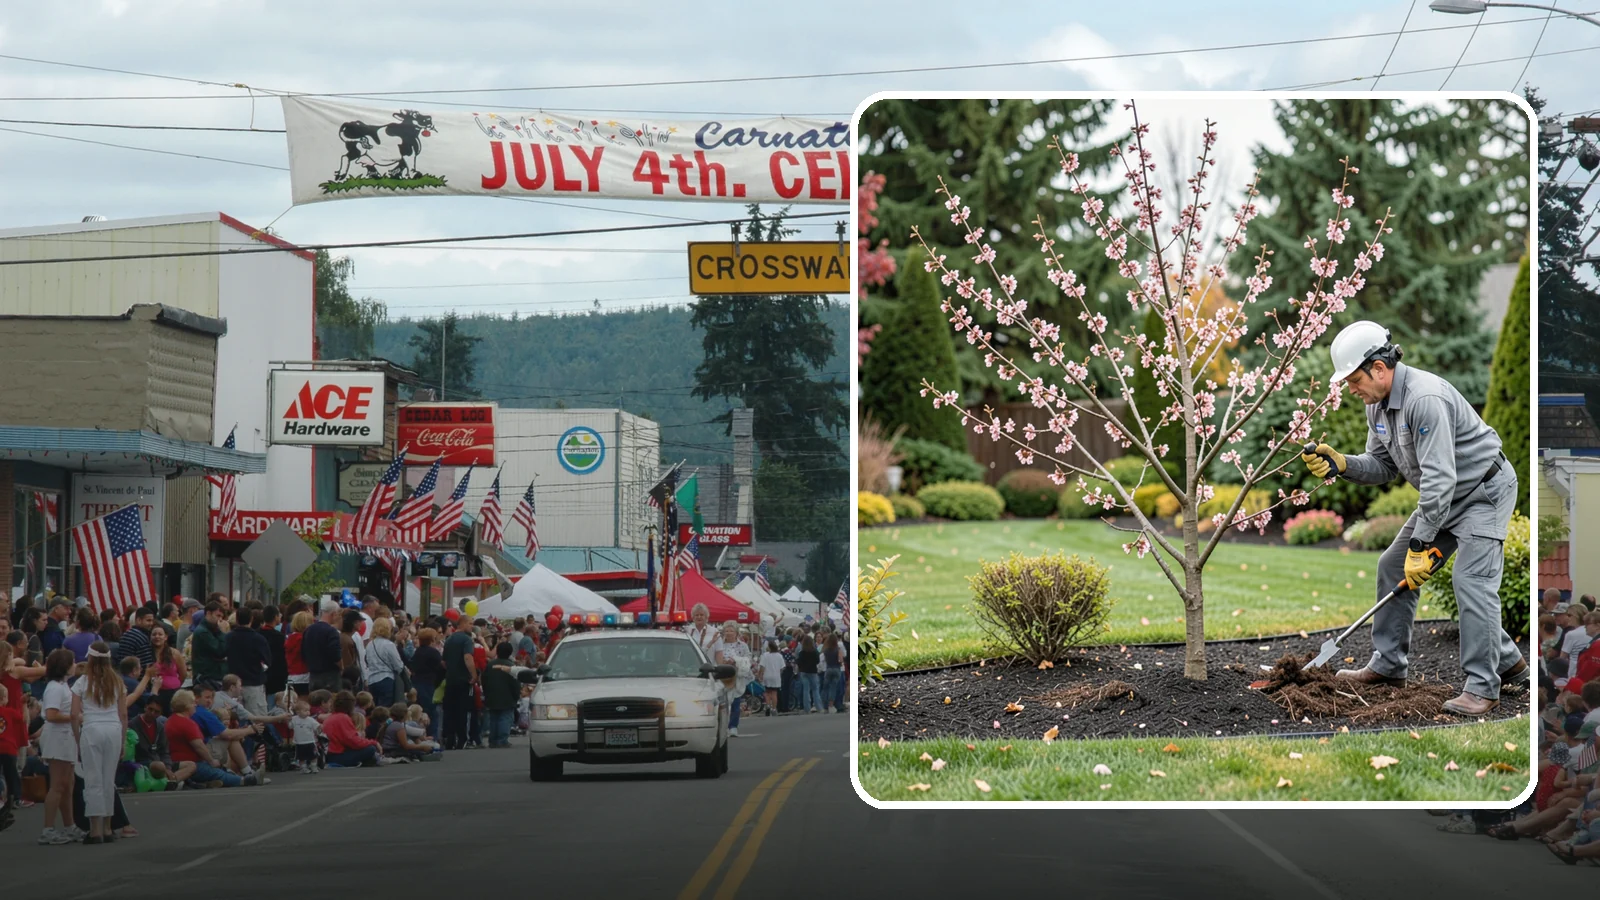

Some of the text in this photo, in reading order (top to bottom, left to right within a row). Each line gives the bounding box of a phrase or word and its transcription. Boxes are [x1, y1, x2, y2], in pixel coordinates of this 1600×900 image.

[481, 140, 605, 193] JULY
[632, 150, 747, 198] 4th.
[283, 380, 374, 420] ACE
[405, 409, 486, 422] CEDAR LOG
[283, 421, 371, 437] Hardware
[416, 428, 477, 447] Coca-Cola
[96, 485, 124, 495] Vincent
[126, 485, 136, 495] de
[138, 486, 155, 496] Paul
[688, 526, 741, 535] CRNATION
[699, 535, 731, 543] GLASS
